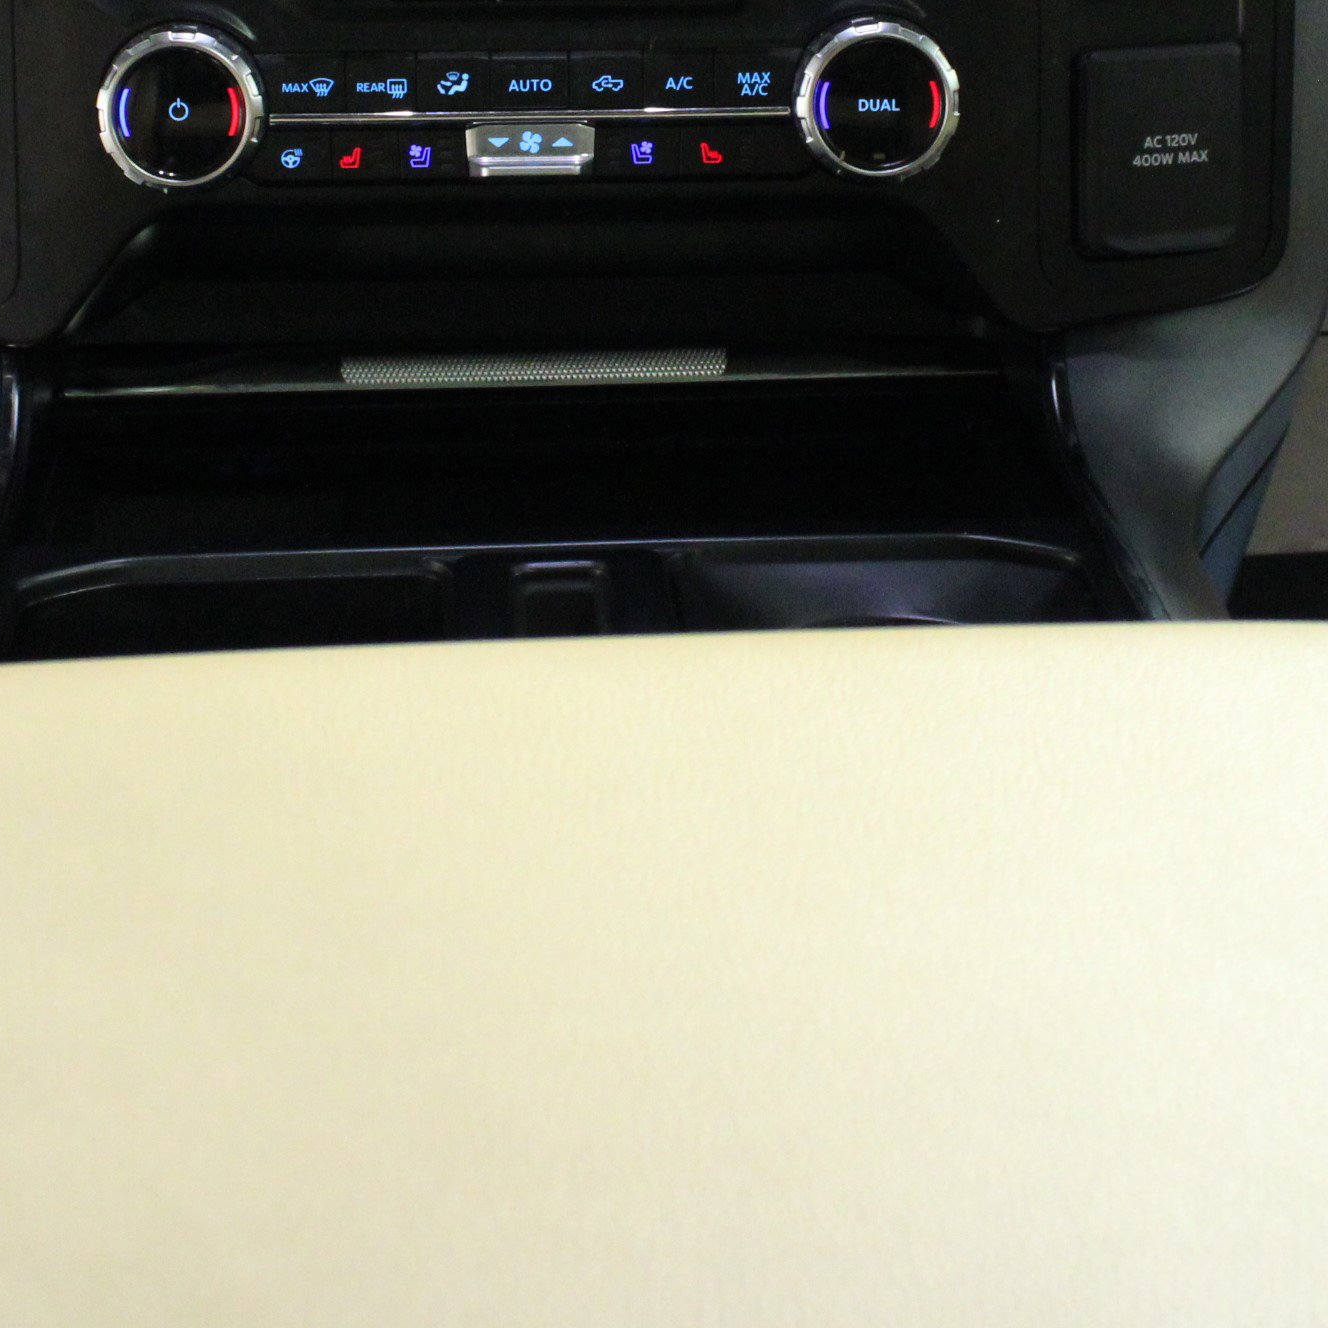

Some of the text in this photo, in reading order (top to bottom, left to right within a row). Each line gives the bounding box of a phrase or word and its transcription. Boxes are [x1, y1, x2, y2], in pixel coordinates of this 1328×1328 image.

[665, 76, 693, 90] A/C
[737, 72, 771, 85] MAX
[282, 83, 309, 94] MAX
[356, 82, 386, 93] REAR
[508, 79, 552, 93] AUTO
[741, 83, 768, 96] A/C
[858, 99, 900, 112] DUAL
[1144, 133, 1198, 149] AC 120V
[1132, 149, 1208, 167] 400W MAX
